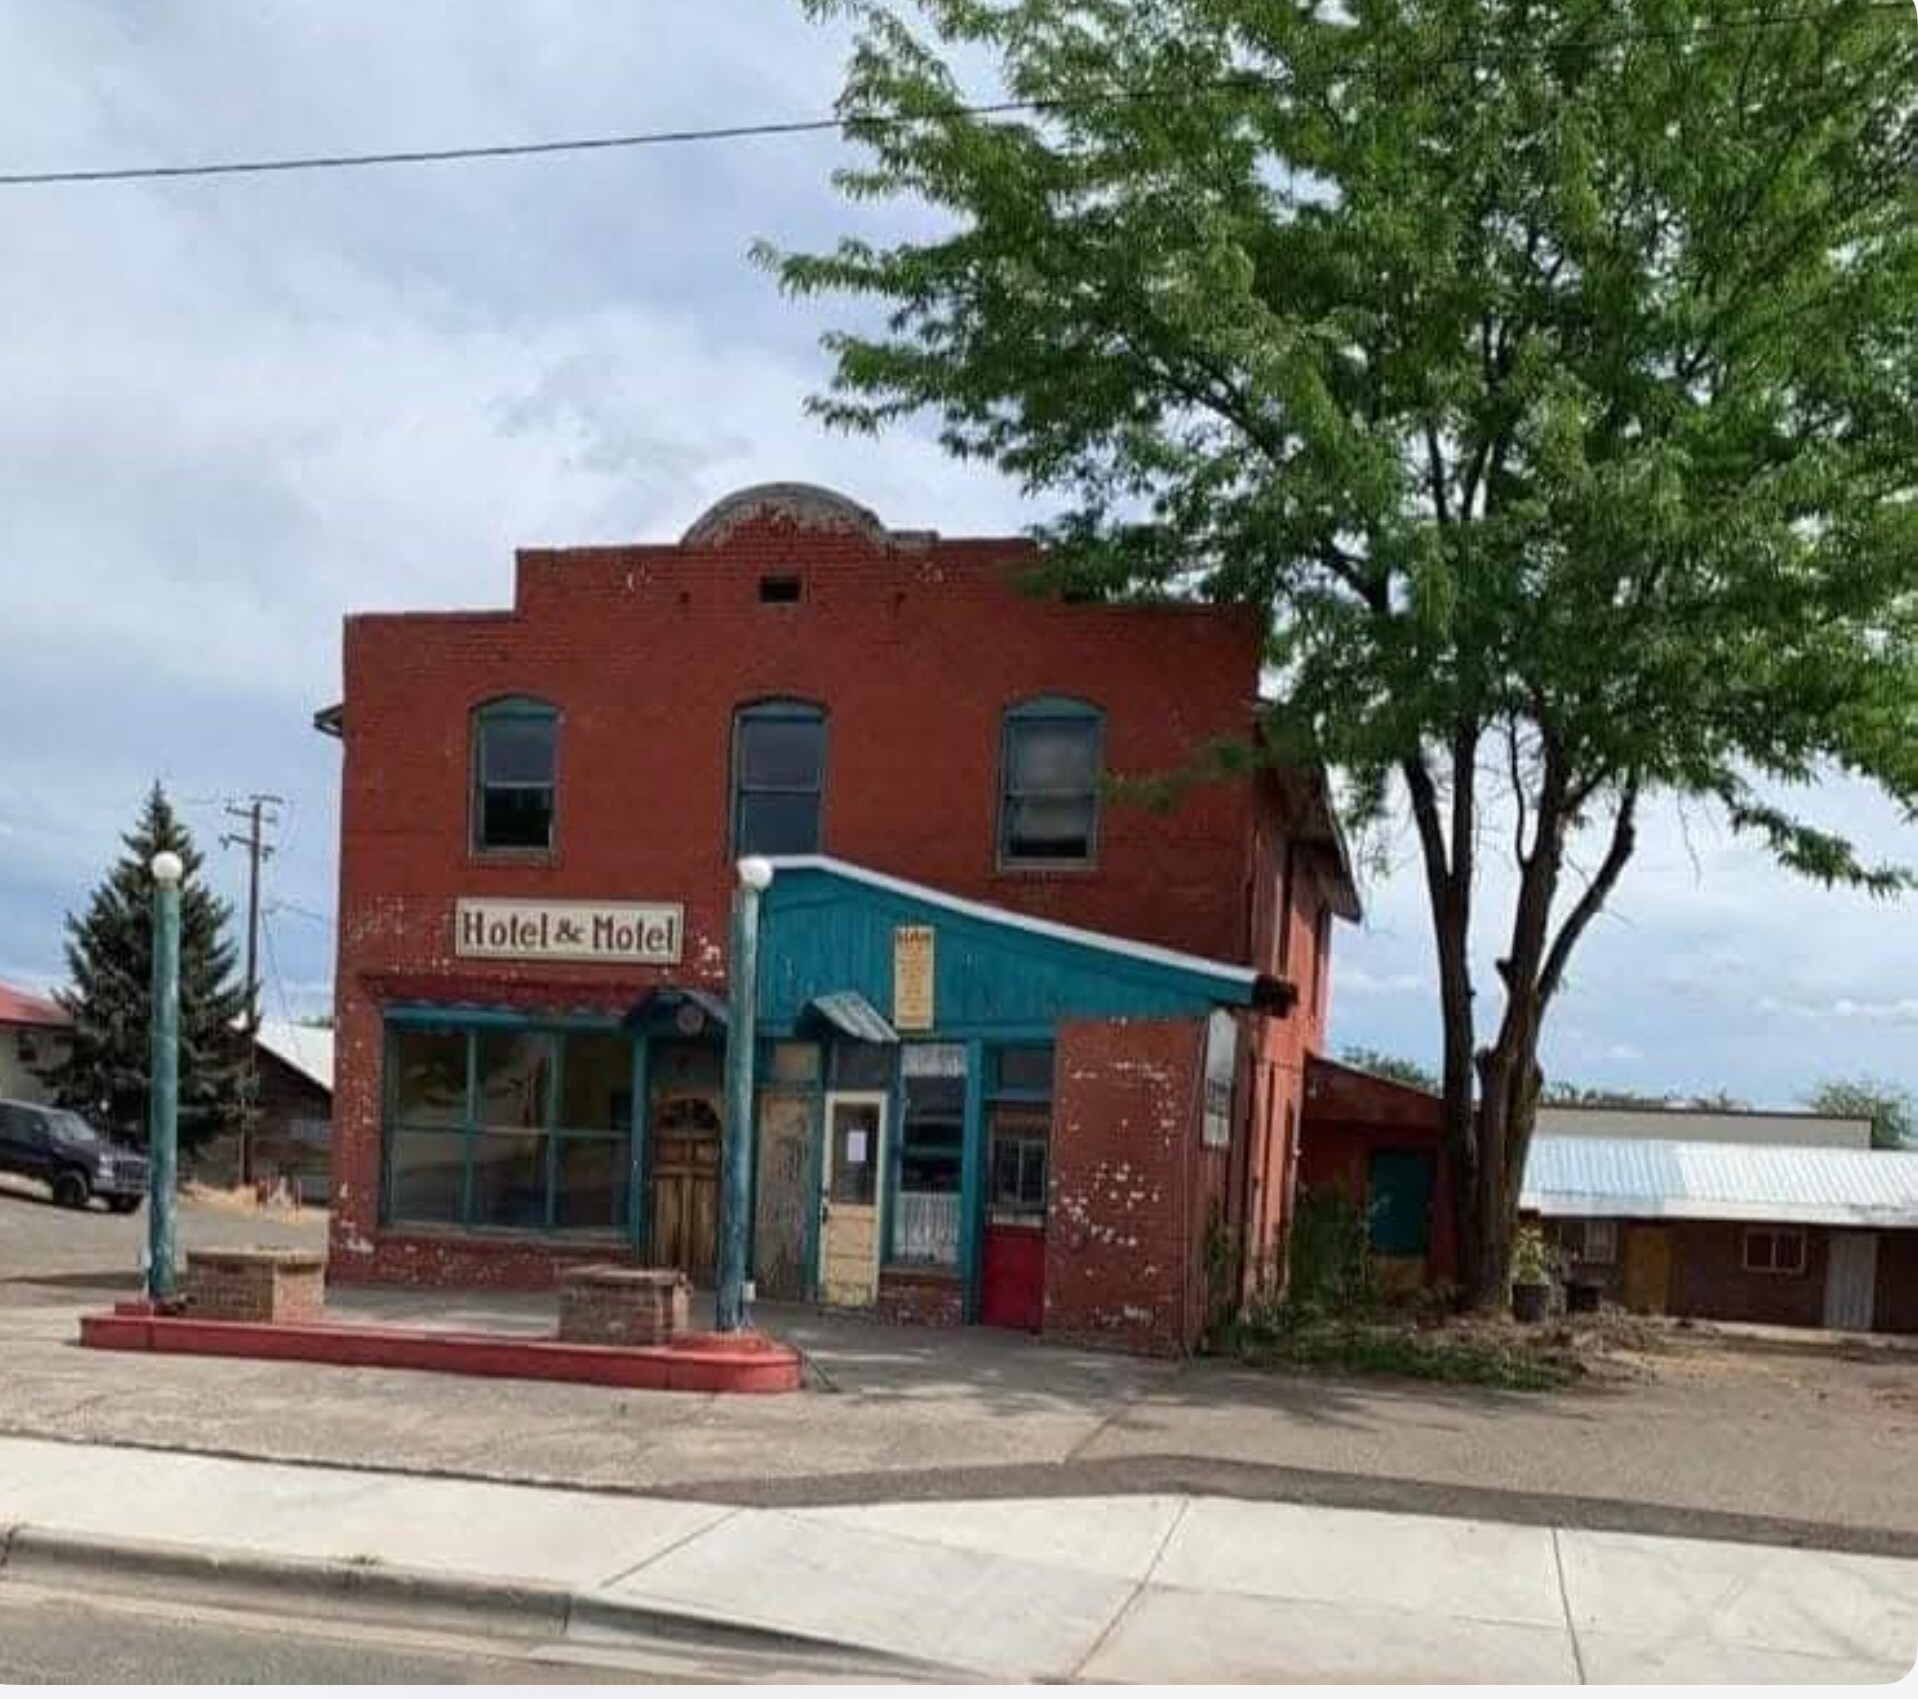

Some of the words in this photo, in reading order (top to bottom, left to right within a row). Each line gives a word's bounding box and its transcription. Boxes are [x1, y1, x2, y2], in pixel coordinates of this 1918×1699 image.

[463, 911, 548, 947] Hotel
[554, 917, 584, 943] &
[592, 914, 674, 952] Motel
